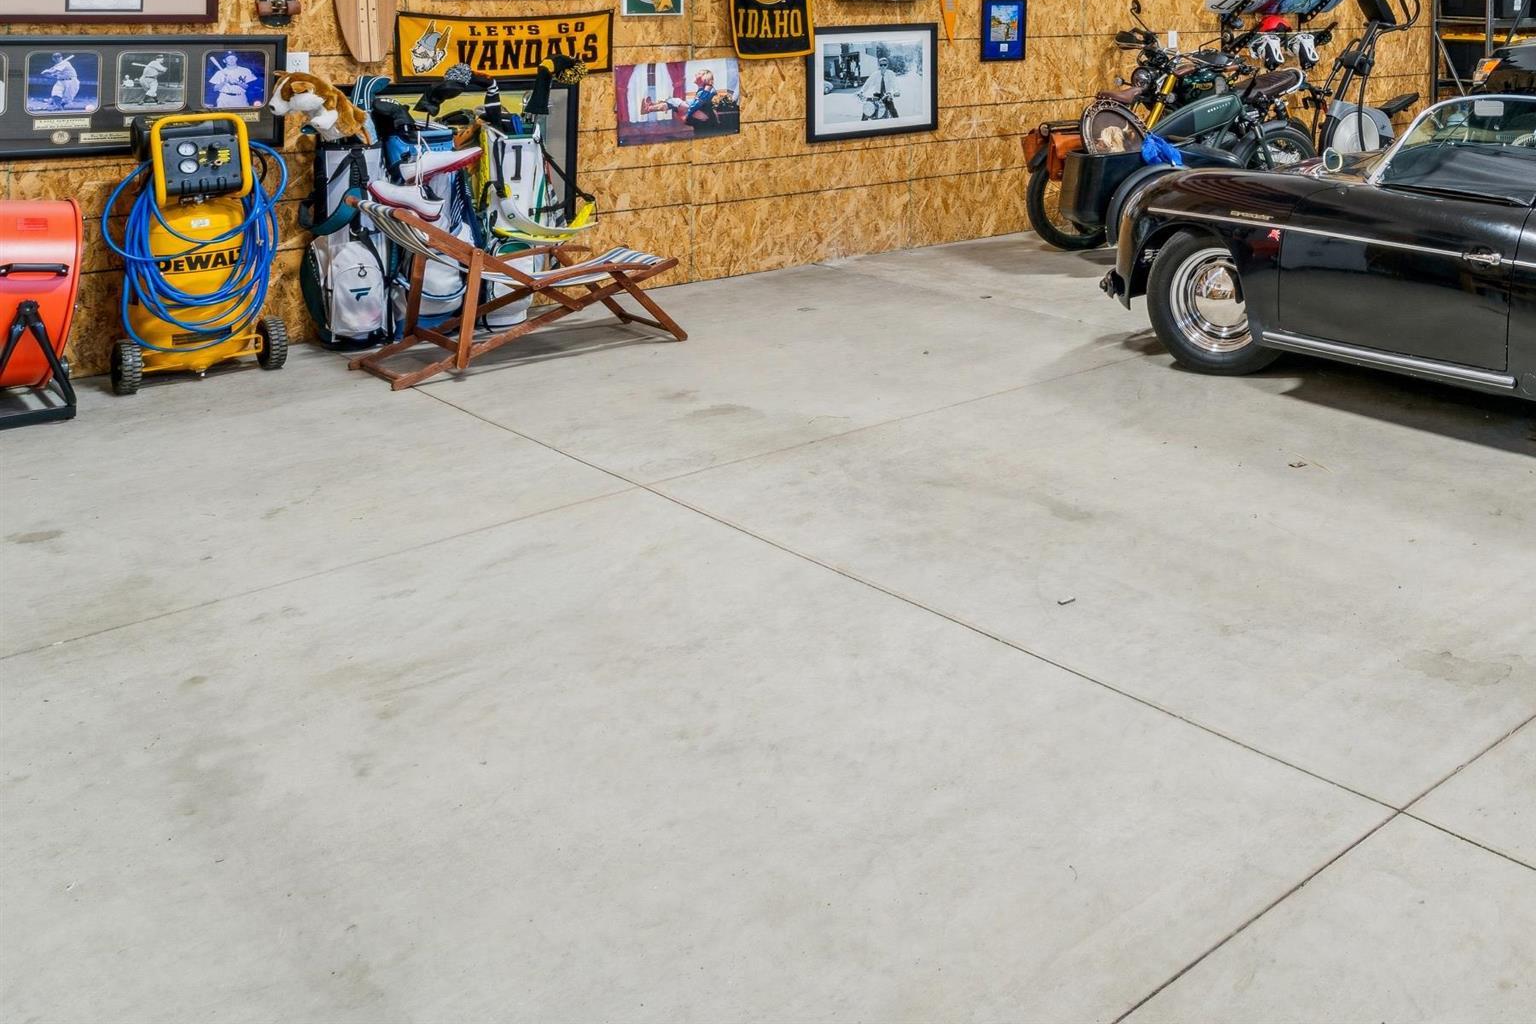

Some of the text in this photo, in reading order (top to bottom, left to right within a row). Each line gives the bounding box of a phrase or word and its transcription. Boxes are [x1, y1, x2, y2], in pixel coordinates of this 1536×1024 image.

[469, 22, 585, 36] LET'S GO
[738, 8, 803, 38] IDAHO
[457, 33, 598, 71] VANDALS
